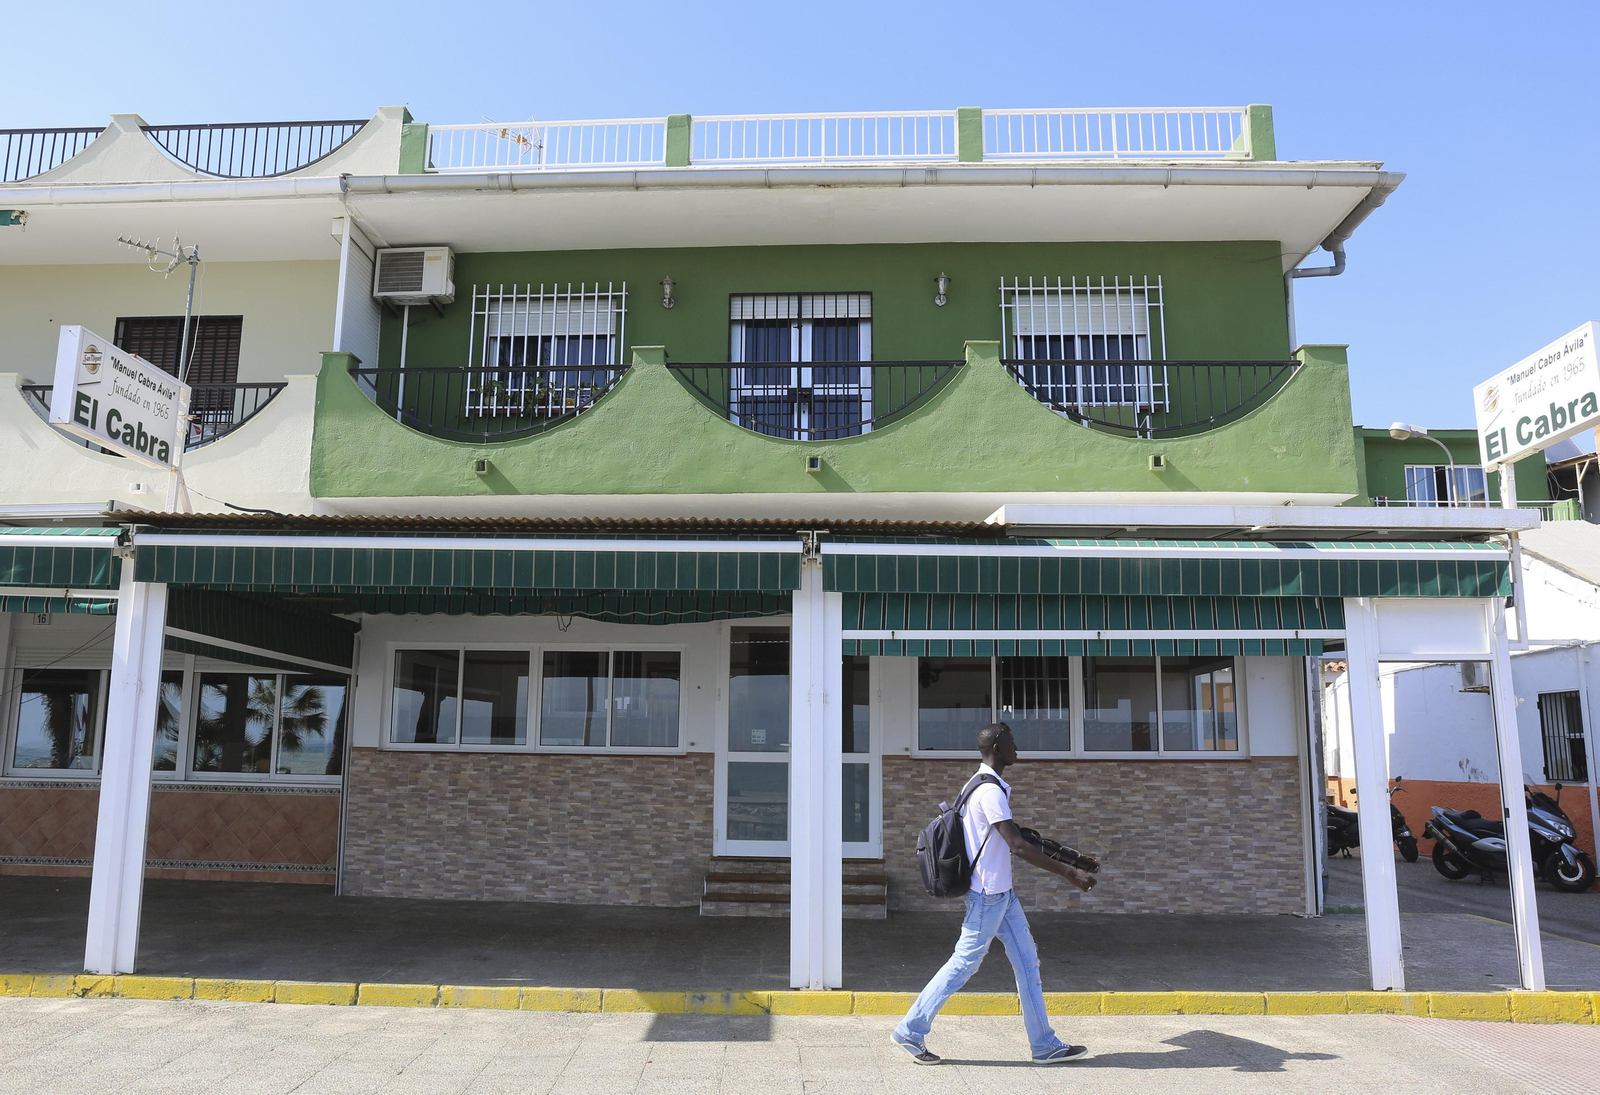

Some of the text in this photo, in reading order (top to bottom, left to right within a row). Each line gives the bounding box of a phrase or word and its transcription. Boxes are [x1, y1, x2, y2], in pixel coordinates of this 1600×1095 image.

[110, 356, 176, 400] "Manuel Cabra Ávila"
[1506, 333, 1588, 386] "Manuel Cabra Ávila"
[1512, 375, 1546, 413] fundado
[1550, 374, 1559, 387] en
[1564, 356, 1585, 382] 1965
[108, 377, 170, 420] fundado en 1965
[74, 390, 170, 464] El Cabra
[1485, 426, 1508, 462] El
[1516, 392, 1598, 446] Cabra
[38, 614, 46, 624] 16
